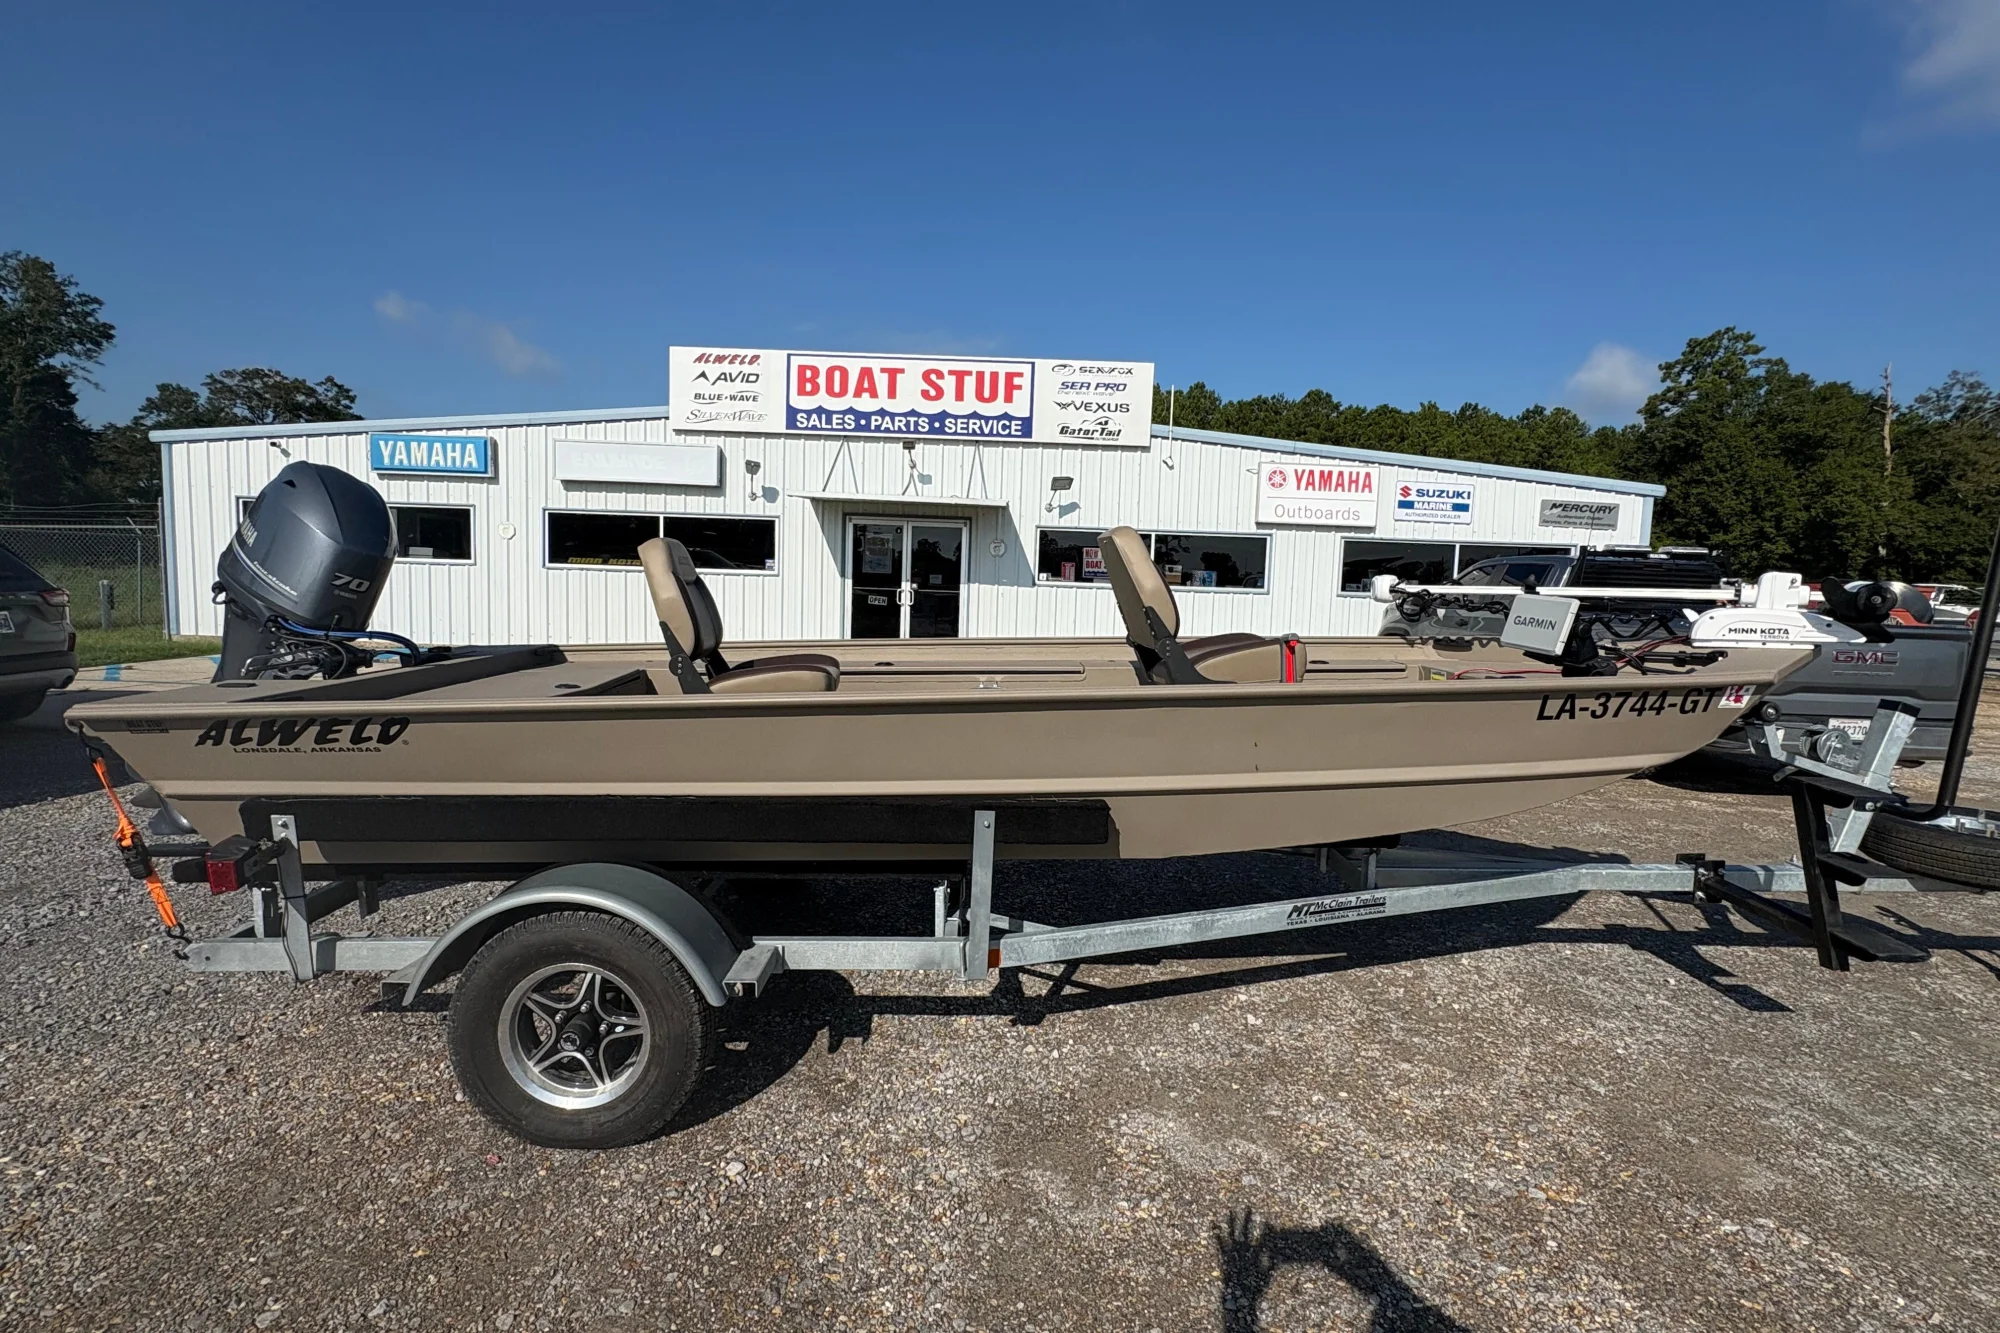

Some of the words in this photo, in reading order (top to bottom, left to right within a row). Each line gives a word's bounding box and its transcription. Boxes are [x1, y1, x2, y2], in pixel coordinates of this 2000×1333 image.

[692, 353, 761, 365] ALWELD
[711, 370, 760, 386] AVID
[797, 364, 905, 400] BOAT
[920, 368, 1024, 404] STUF
[1058, 381, 1091, 390] SEA
[1094, 382, 1127, 392] PRO
[1070, 400, 1130, 414] VEXUS
[796, 413, 855, 430] SALES
[870, 416, 929, 432] PARTS
[944, 418, 1022, 435] SERVICE
[1059, 425, 1122, 437] GatorTail
[379, 440, 479, 469] YAMAHA
[1294, 468, 1373, 493] YAMAHA
[1415, 488, 1471, 500] SUZUKI
[1274, 504, 1361, 521] Outboards
[1414, 501, 1453, 511] MARINE
[1549, 503, 1616, 514] MERCURY
[1085, 560, 1103, 570] BOAT
[331, 572, 371, 592] 70
[869, 596, 887, 604] OPEN
[1513, 615, 1557, 631] GARMIN
[1832, 650, 1900, 667] GMC
[1536, 687, 1724, 721] LA-3744-GT
[195, 717, 411, 747] ALWELD
[1314, 897, 1353, 911] McClain
[1354, 894, 1388, 906] Trailers
[1314, 913, 1350, 923] LOUISIANA
